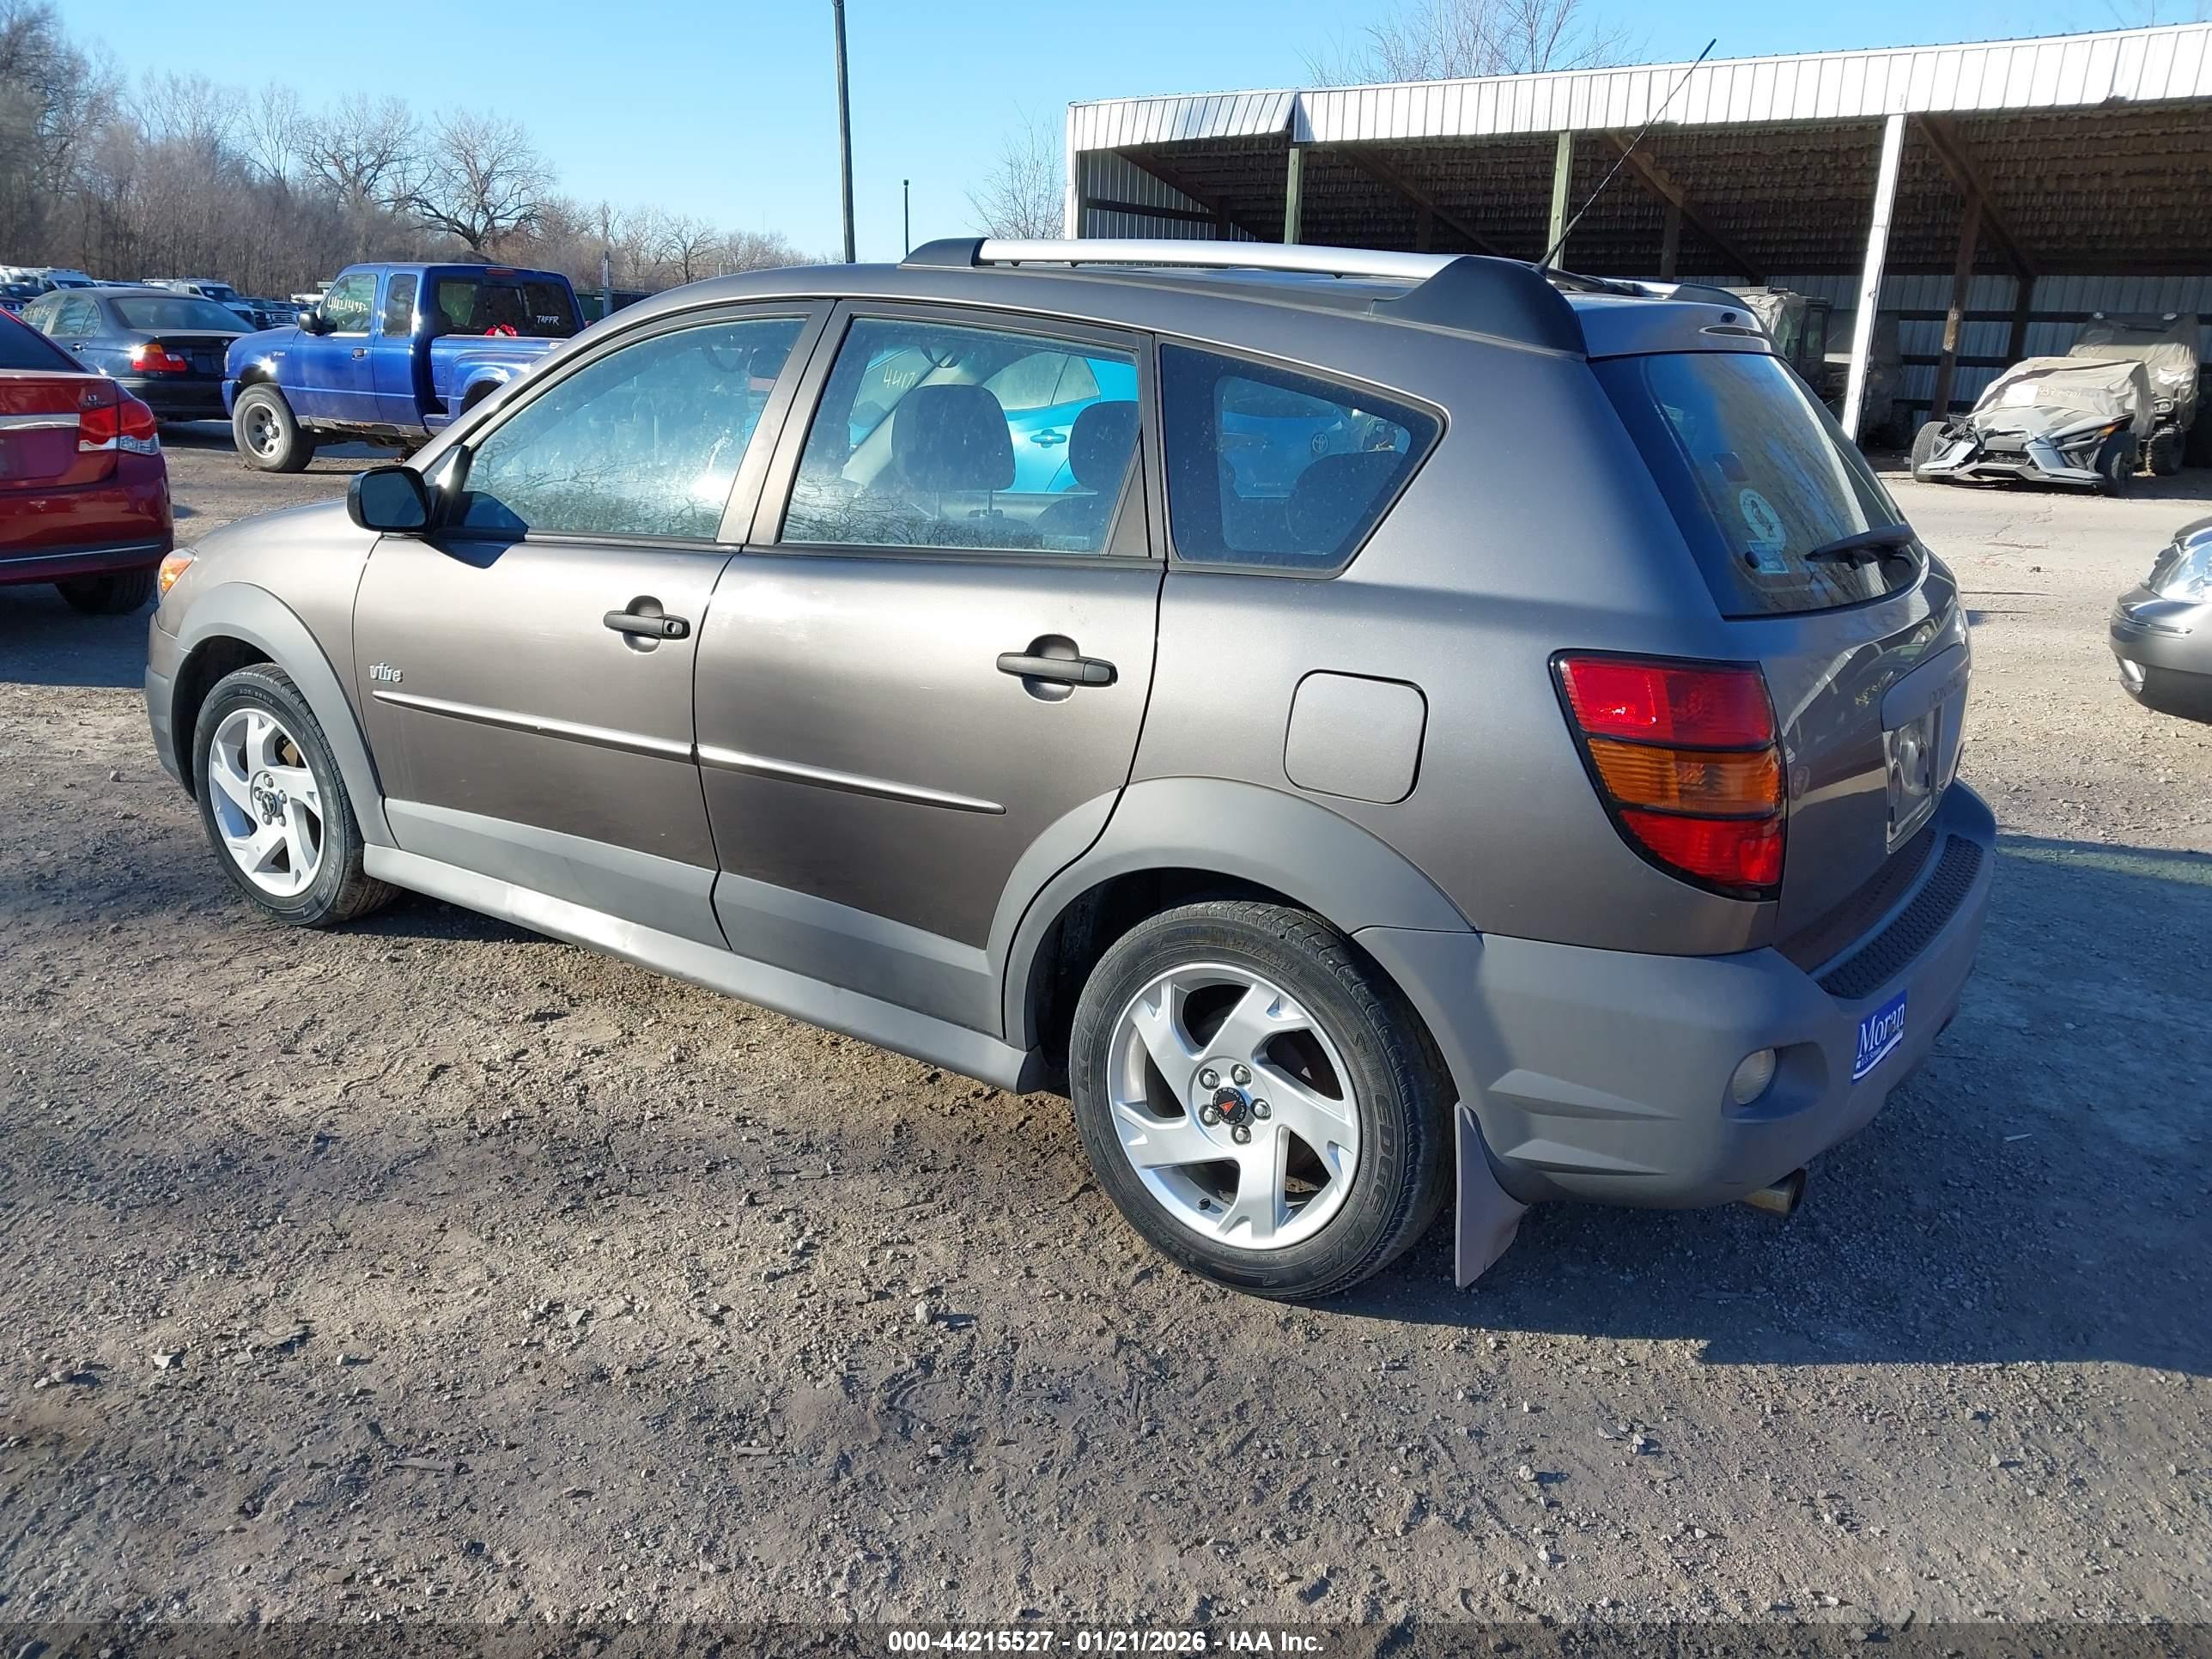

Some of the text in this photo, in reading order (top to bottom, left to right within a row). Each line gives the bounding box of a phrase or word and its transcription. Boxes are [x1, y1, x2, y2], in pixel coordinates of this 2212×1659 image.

[536, 315, 561, 326] TAFFR
[369, 662, 403, 683] vibe
[1856, 1002, 1905, 1060] Moran
[1369, 1093, 1395, 1216] EDGE
